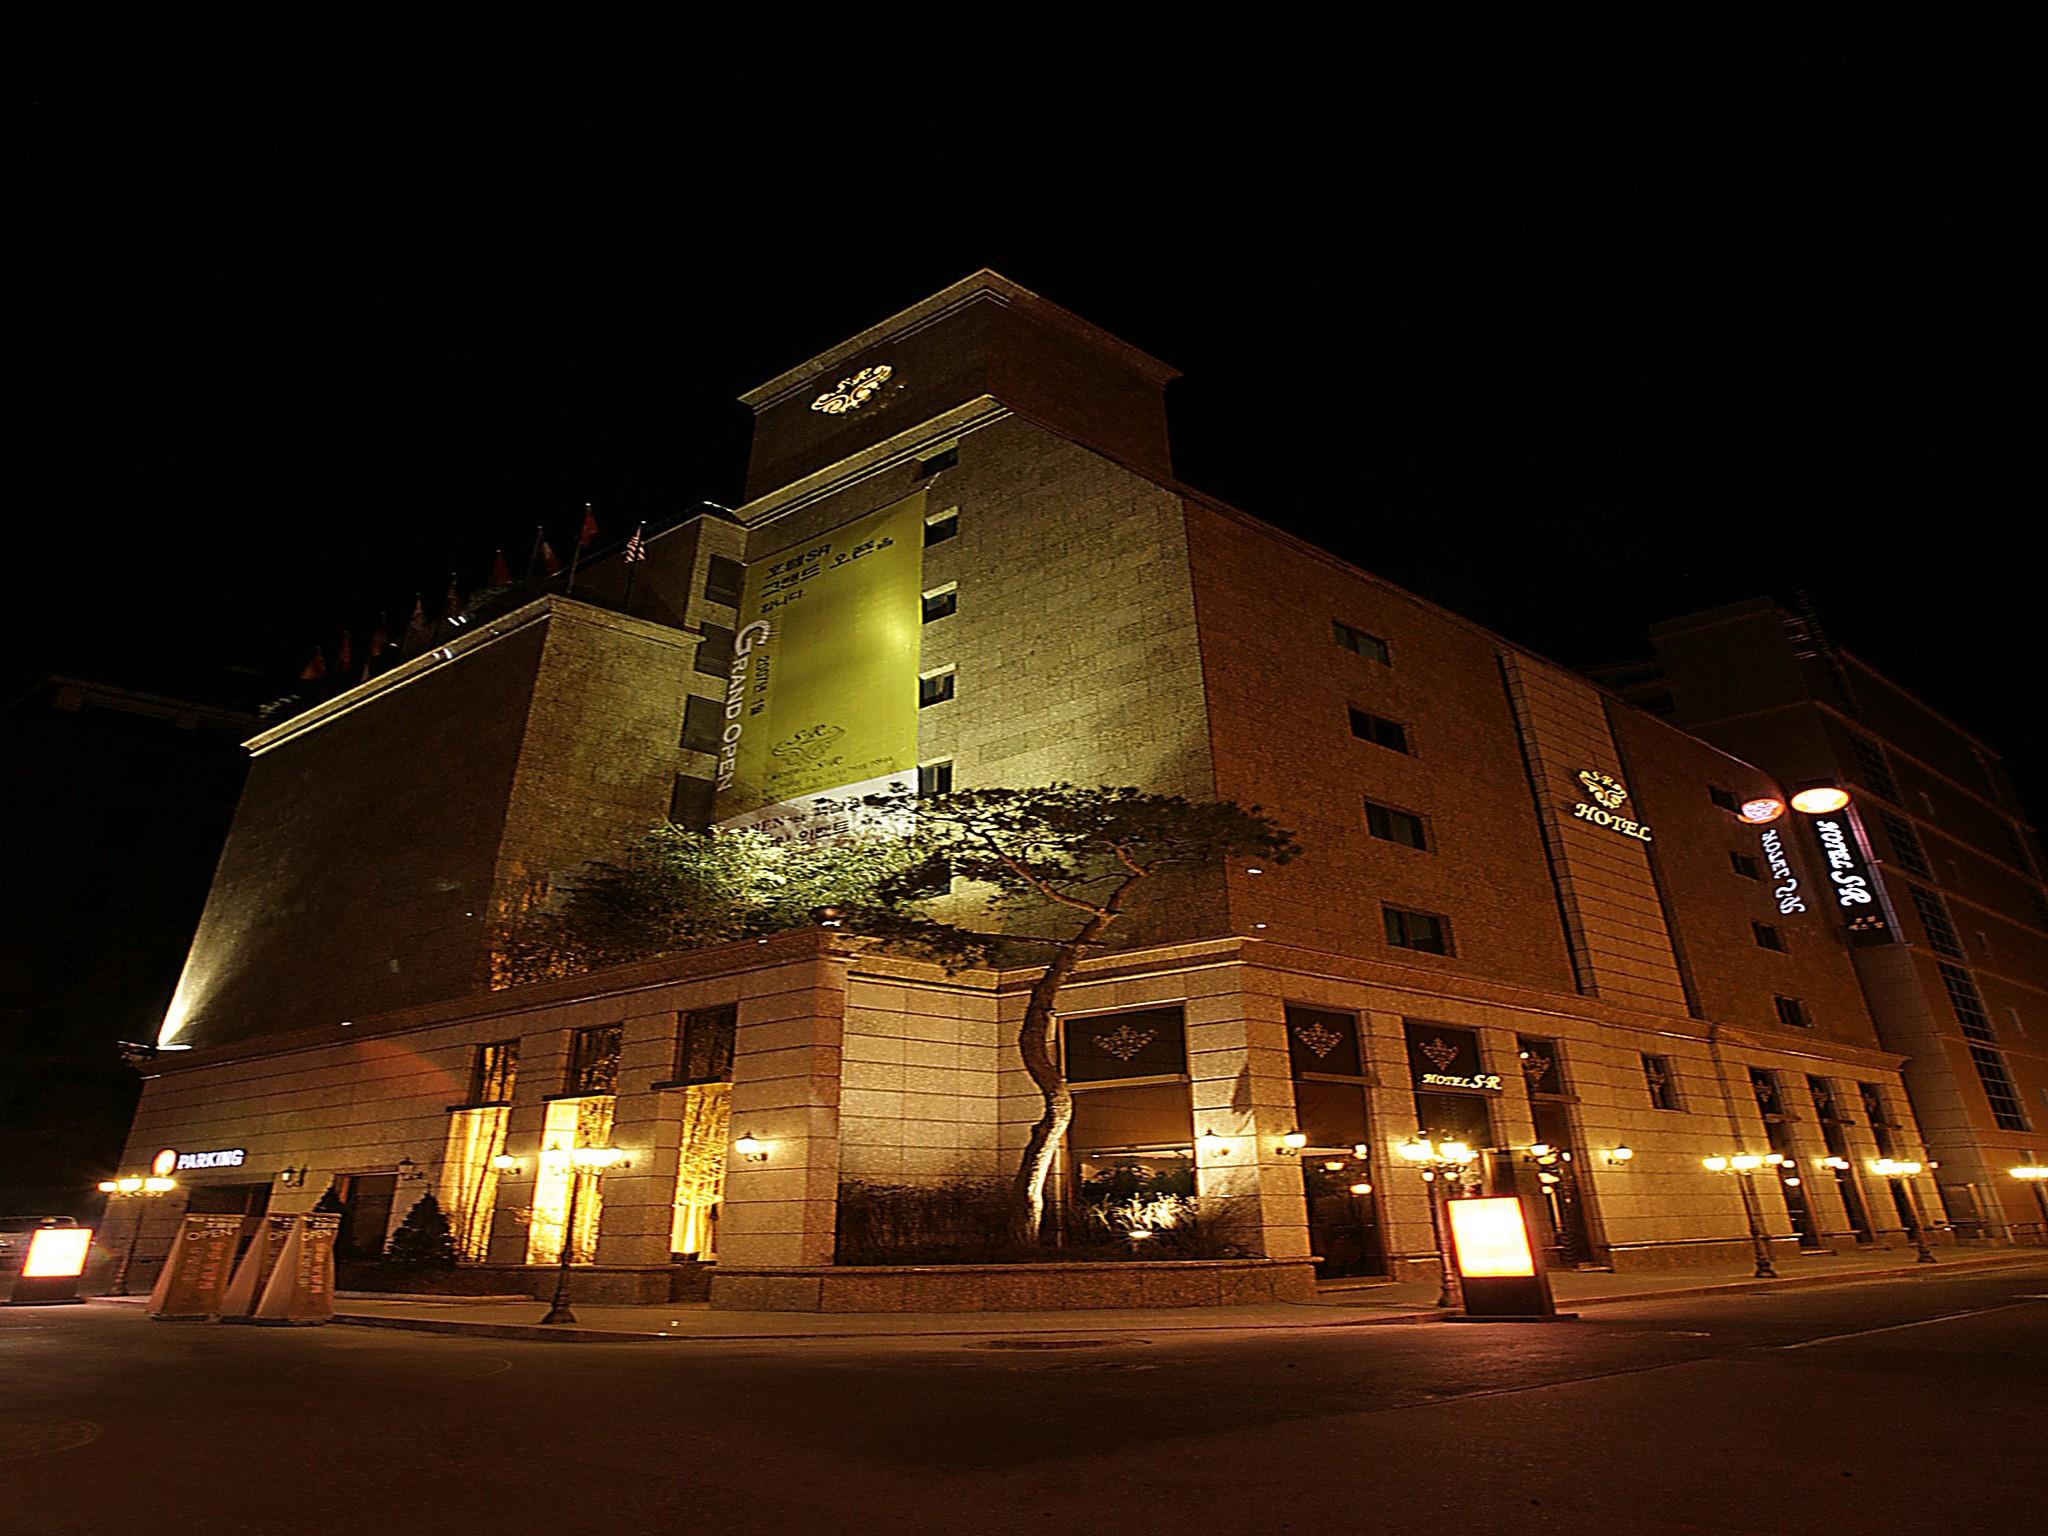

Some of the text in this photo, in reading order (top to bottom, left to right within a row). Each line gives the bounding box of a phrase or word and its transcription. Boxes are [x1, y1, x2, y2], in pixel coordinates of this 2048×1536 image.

[761, 563, 821, 598] 그랜드
[717, 619, 770, 793] GRAND OPEN
[1574, 803, 1652, 841] HOTEL
[1816, 820, 1854, 869] HOTEL
[1421, 1073, 1470, 1088] HOTEL
[177, 1149, 245, 1170] PARKING
[185, 1227, 234, 1241] OPEN
